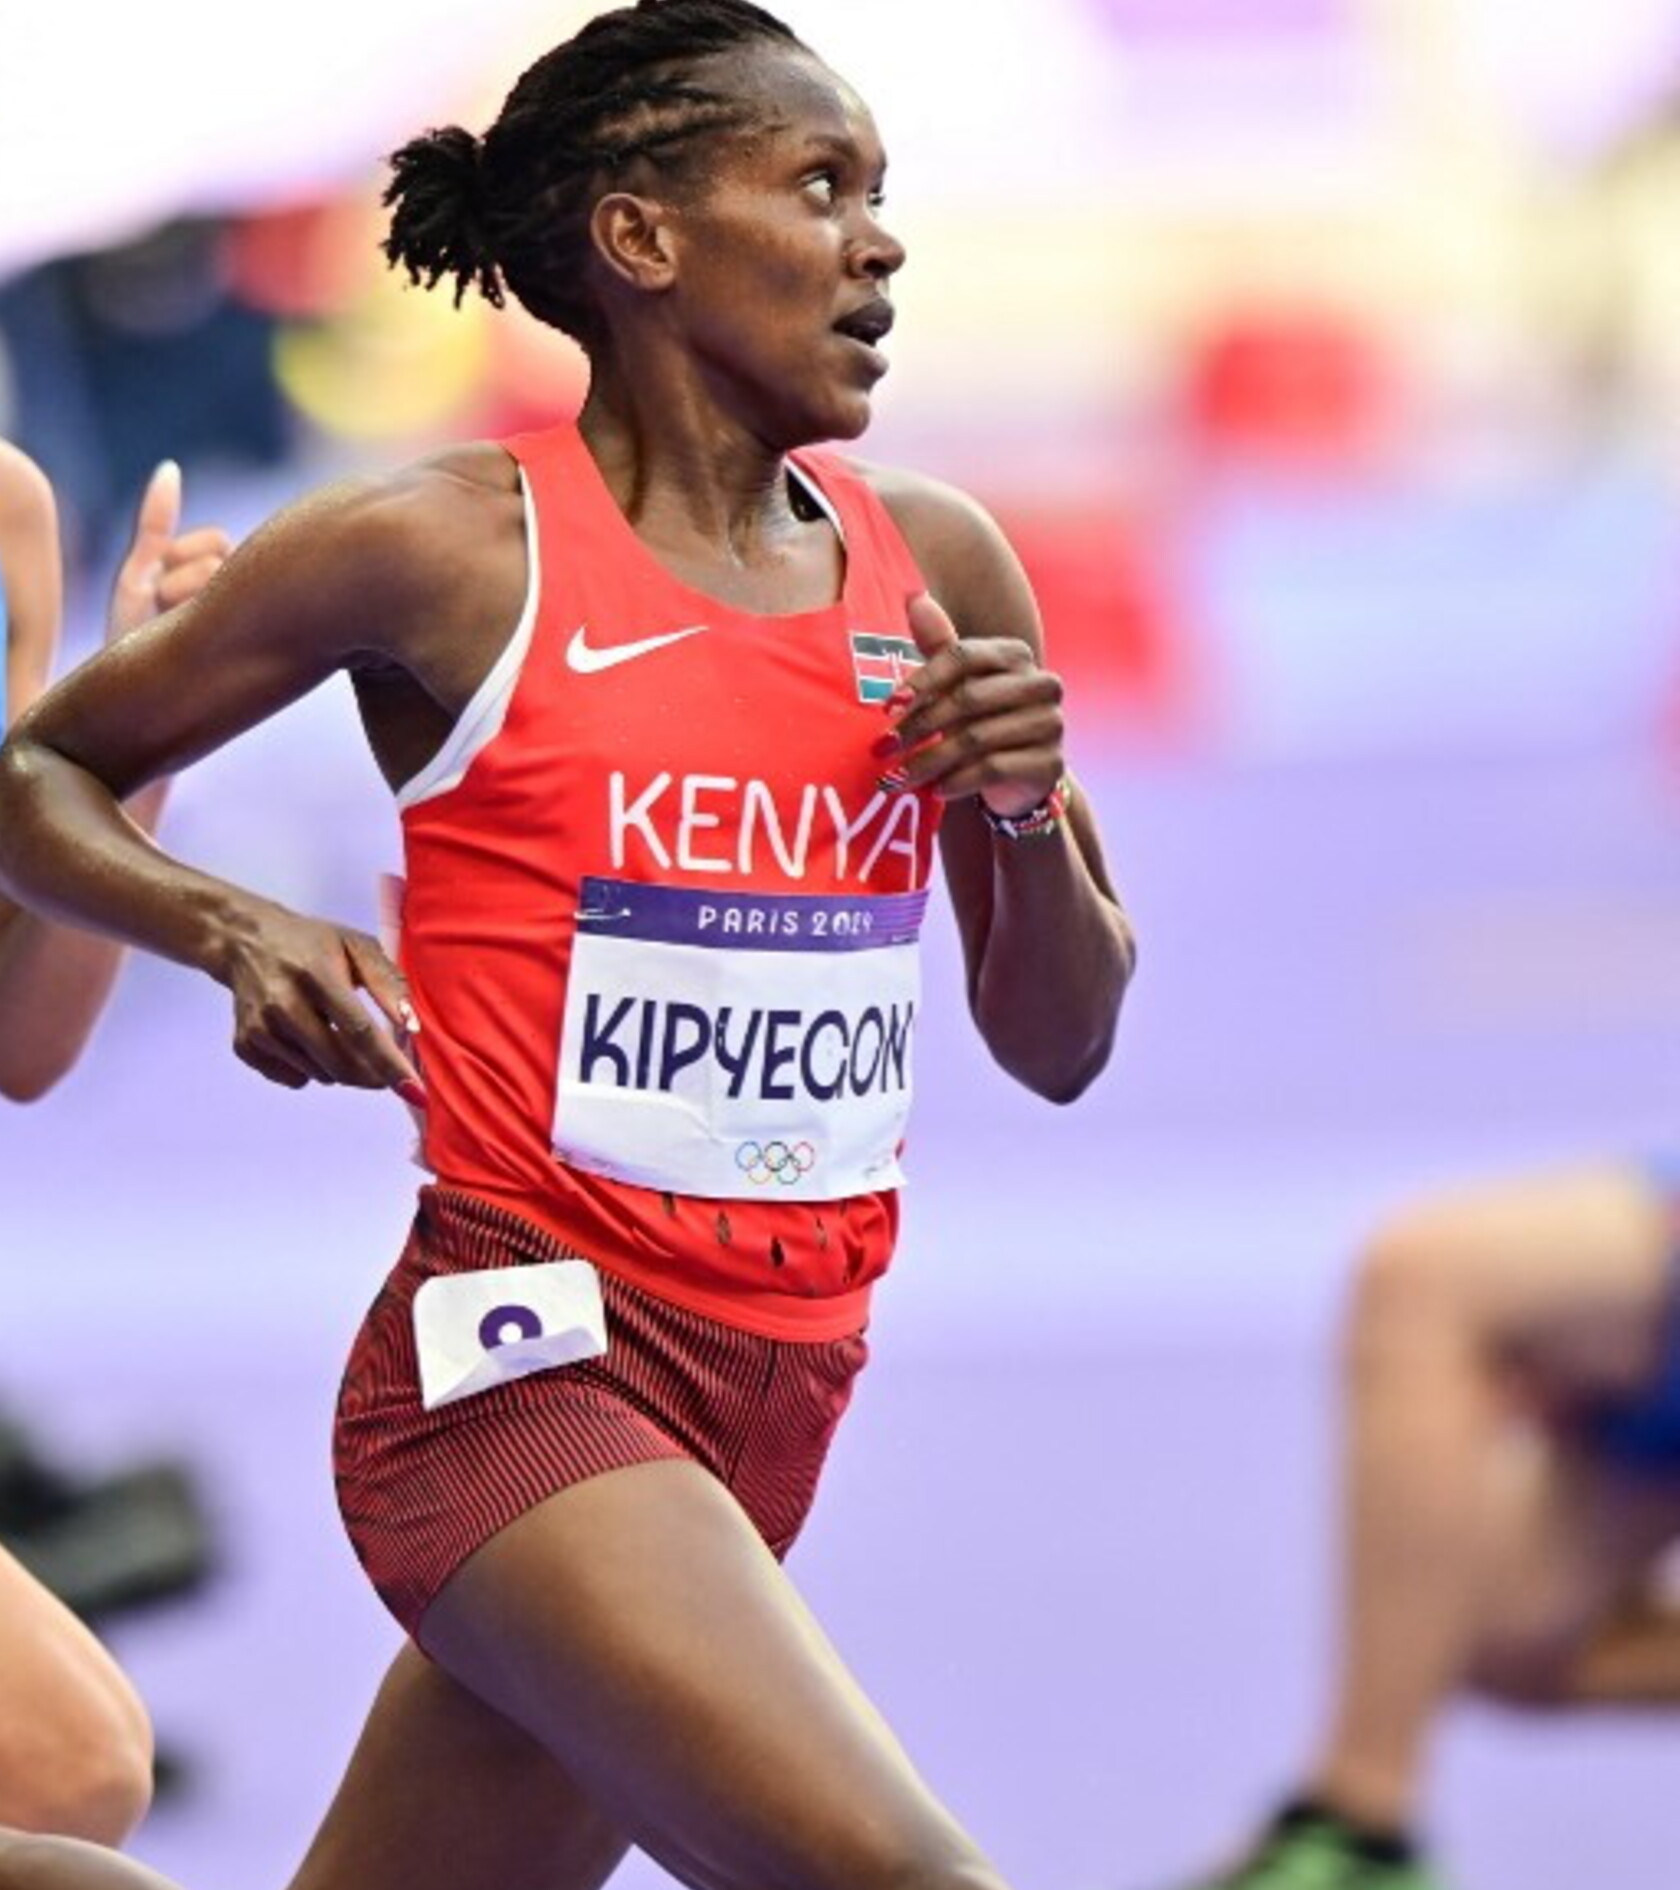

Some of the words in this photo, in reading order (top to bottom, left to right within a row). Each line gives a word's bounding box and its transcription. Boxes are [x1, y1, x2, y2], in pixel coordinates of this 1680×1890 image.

[608, 770, 920, 894] KENYA
[697, 904, 800, 937] PARIS
[578, 992, 914, 1102] KIPYEGON
